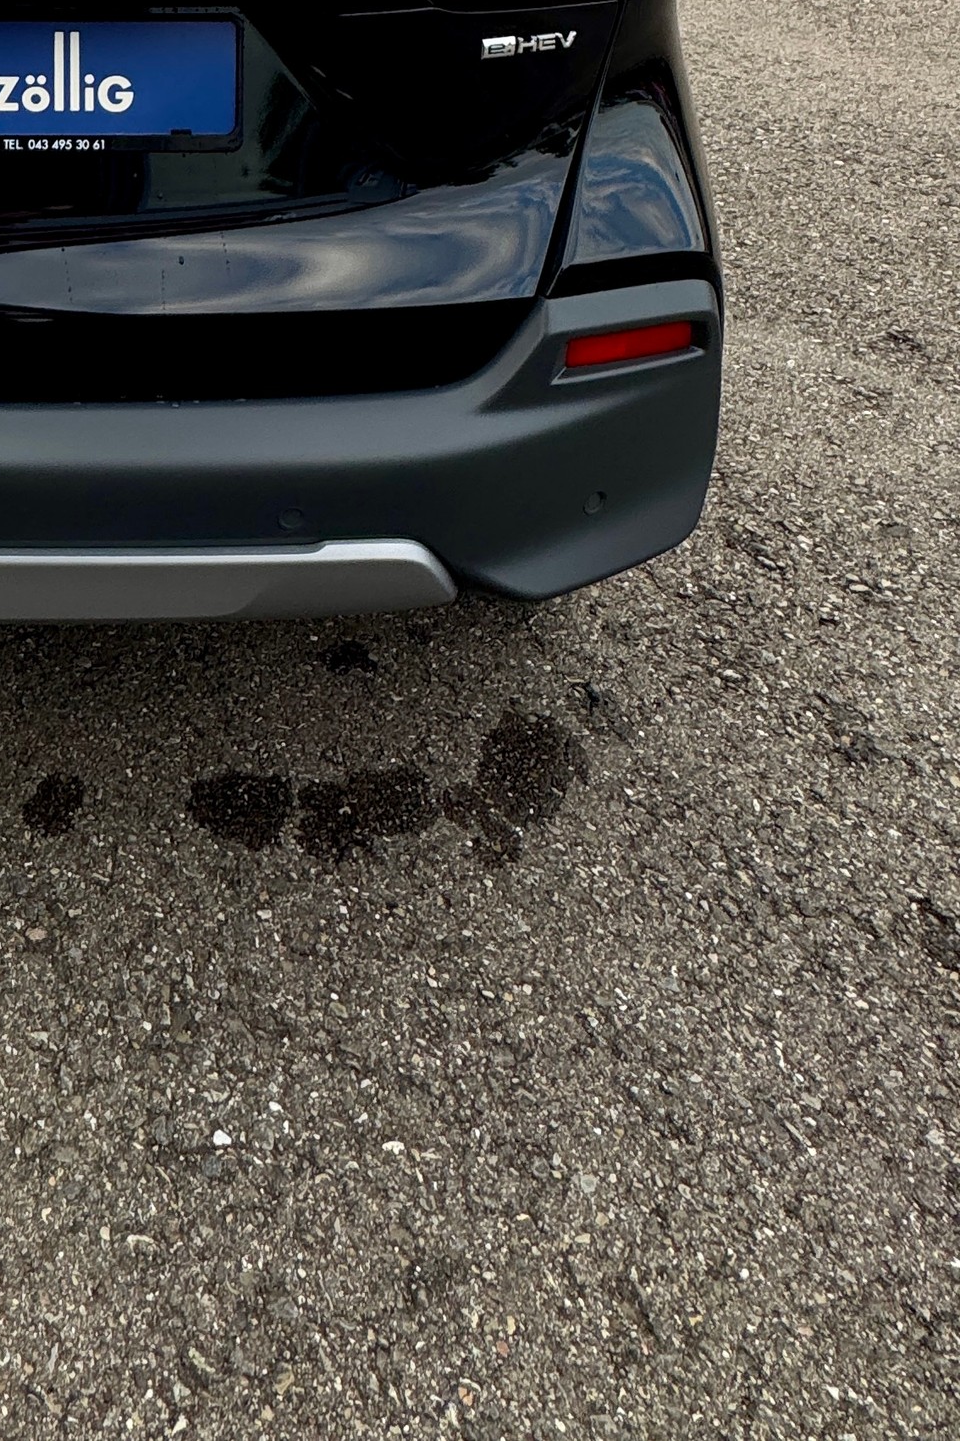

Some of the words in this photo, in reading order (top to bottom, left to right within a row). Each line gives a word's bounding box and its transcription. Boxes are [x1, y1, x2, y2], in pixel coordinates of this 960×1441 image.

[27, 138, 49, 150] 043
[51, 138, 73, 150] 495
[75, 138, 90, 150] 30
[92, 138, 106, 150] 61
